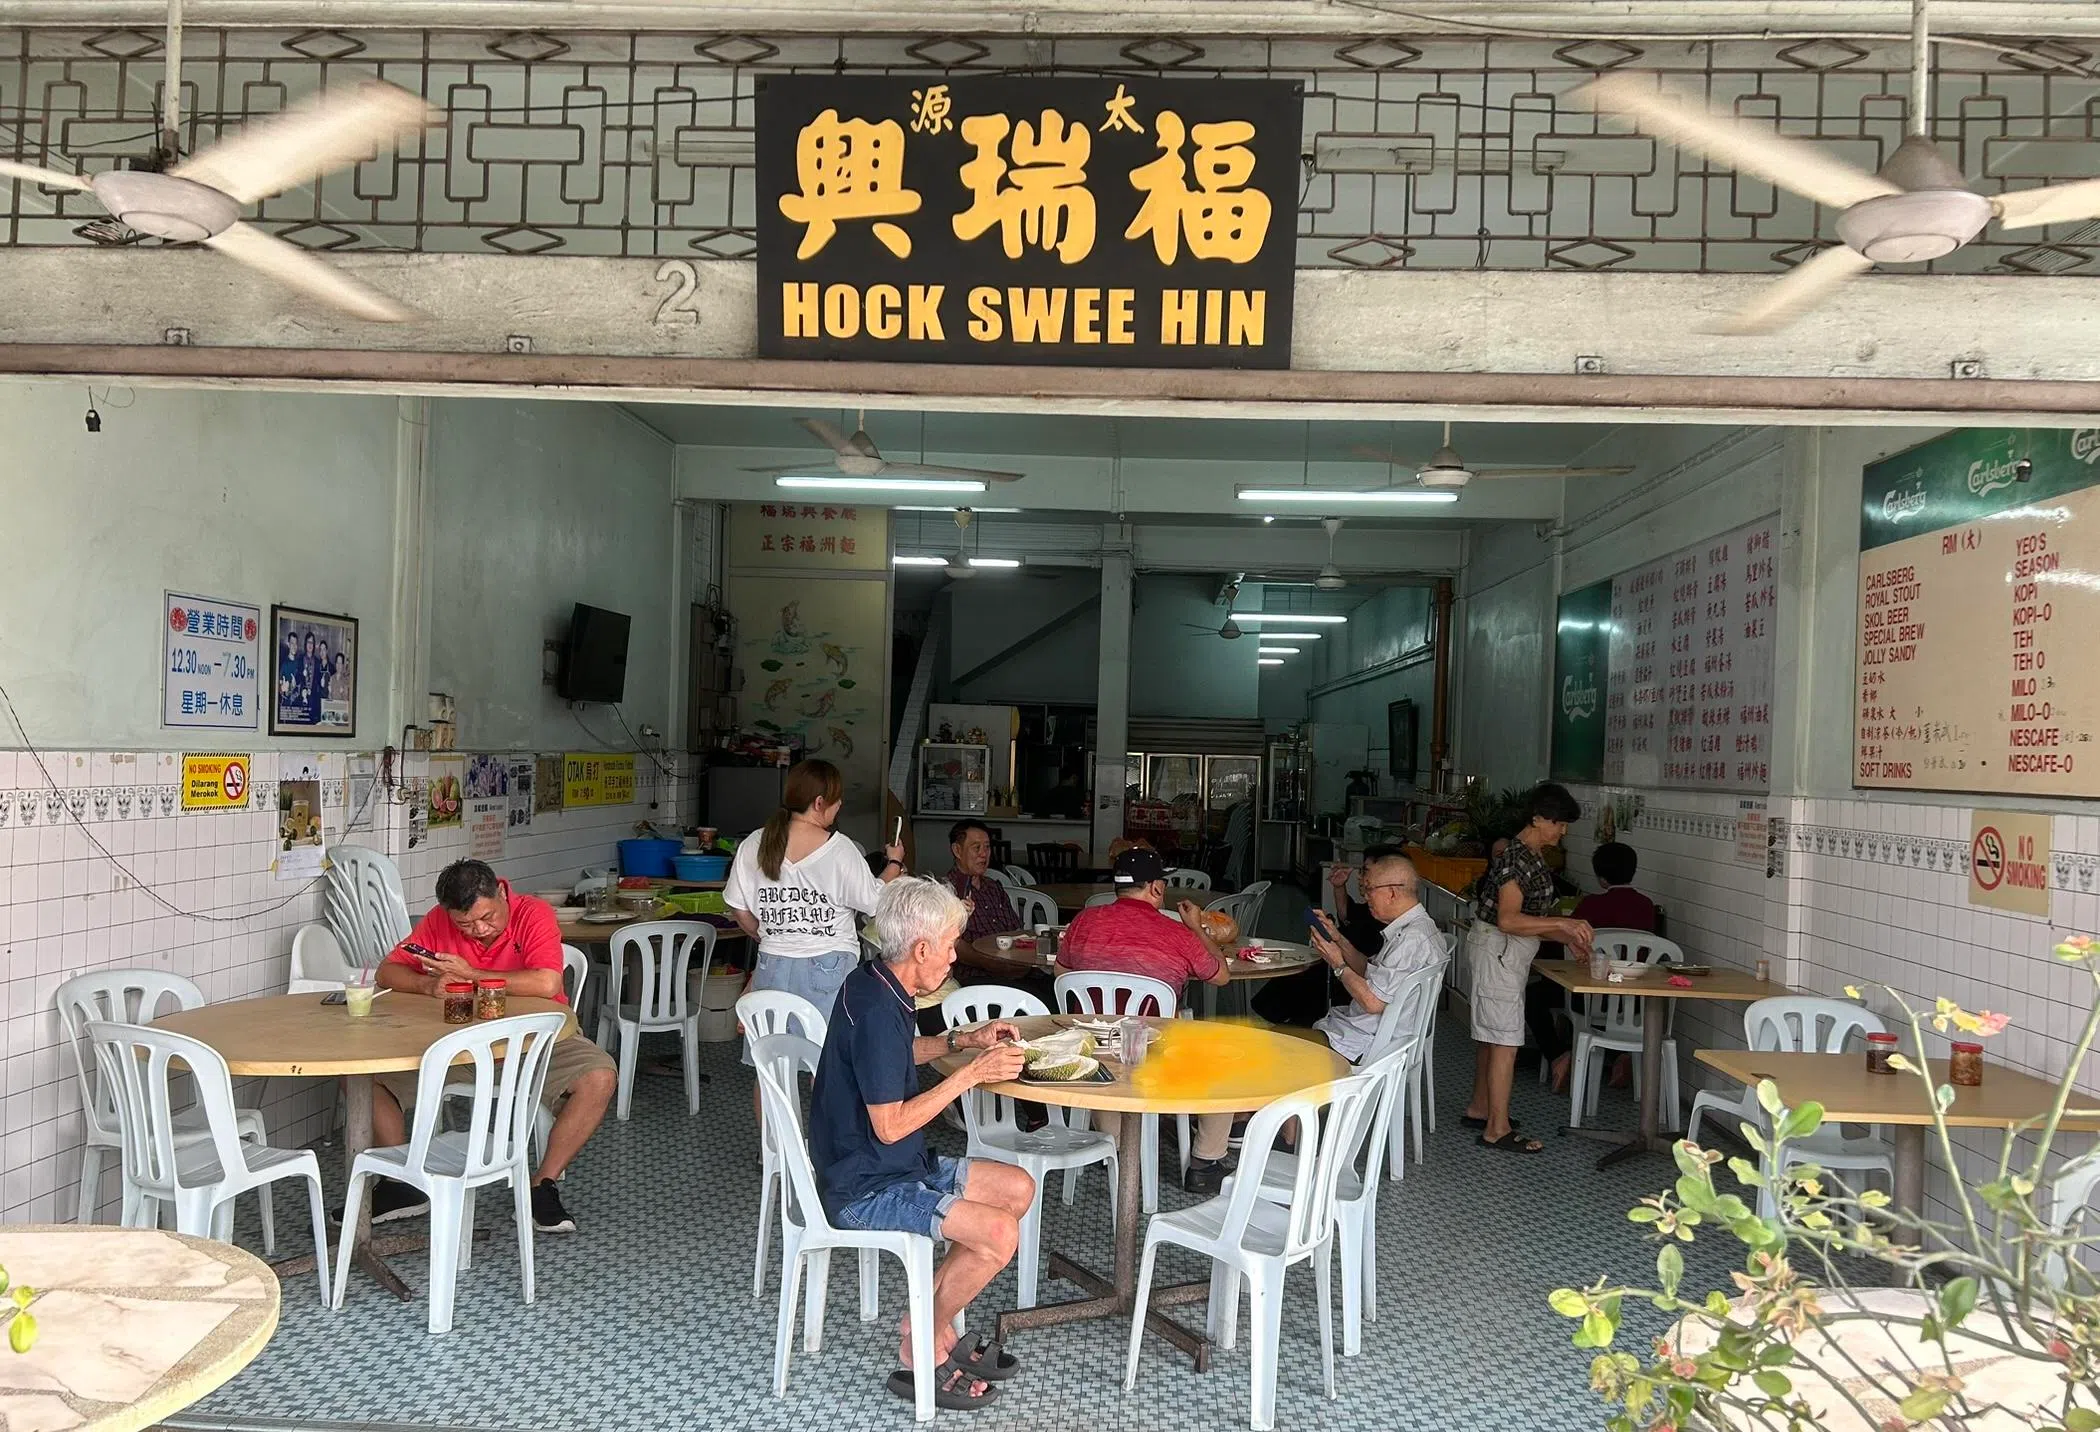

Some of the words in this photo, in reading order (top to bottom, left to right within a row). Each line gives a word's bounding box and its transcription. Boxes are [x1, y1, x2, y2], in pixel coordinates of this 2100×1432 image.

[655, 258, 699, 326] 2
[782, 281, 945, 341] HOCK
[967, 286, 1136, 345] SWEE
[1161, 289, 1266, 347] HIN
[1883, 489, 1927, 524] Carlsberg
[1942, 533, 1958, 555] RM
[2014, 552, 2059, 578] SEASON
[1866, 566, 1915, 591] CARLSBERG
[1865, 589, 1890, 609] ROYAL
[1893, 583, 1922, 604] STOUT
[2013, 582, 2038, 603] KOPI
[187, 607, 243, 640] 營業時間
[1865, 611, 1885, 629] SKOL
[1887, 606, 1909, 626] BEER
[2013, 602, 2052, 626] KOPI-O
[1863, 627, 1896, 647] SPECIAL
[1899, 623, 1926, 642] BREW
[2013, 629, 2034, 649] TEH
[171, 647, 197, 674] 12.30
[197, 663, 212, 675] NOON
[246, 668, 255, 680] PM
[1863, 648, 1887, 666] JOLLY
[1888, 644, 1916, 663] SANDY
[2012, 652, 2033, 671] TEH
[2036, 650, 2046, 669] O
[2011, 677, 2037, 696] MILO
[181, 690, 243, 716] 星期一休息
[1562, 674, 1598, 724] Carlsberg
[1889, 706, 1896, 720] 大
[1915, 706, 1924, 718] 小
[2010, 702, 2051, 721] MILO-O
[2010, 728, 2059, 746] NESCAFE
[188, 764, 197, 774] NO
[198, 764, 222, 774] SMOKING
[568, 760, 585, 782] OTAK
[1860, 762, 1880, 778] SOFT
[1883, 762, 1912, 778] DRINKS
[2008, 754, 2073, 773] NESCAFE-O
[191, 779, 219, 789] Dilarang
[191, 789, 219, 798] Merokok
[2018, 835, 2033, 861] NO
[2007, 861, 2046, 890] SMOKING
